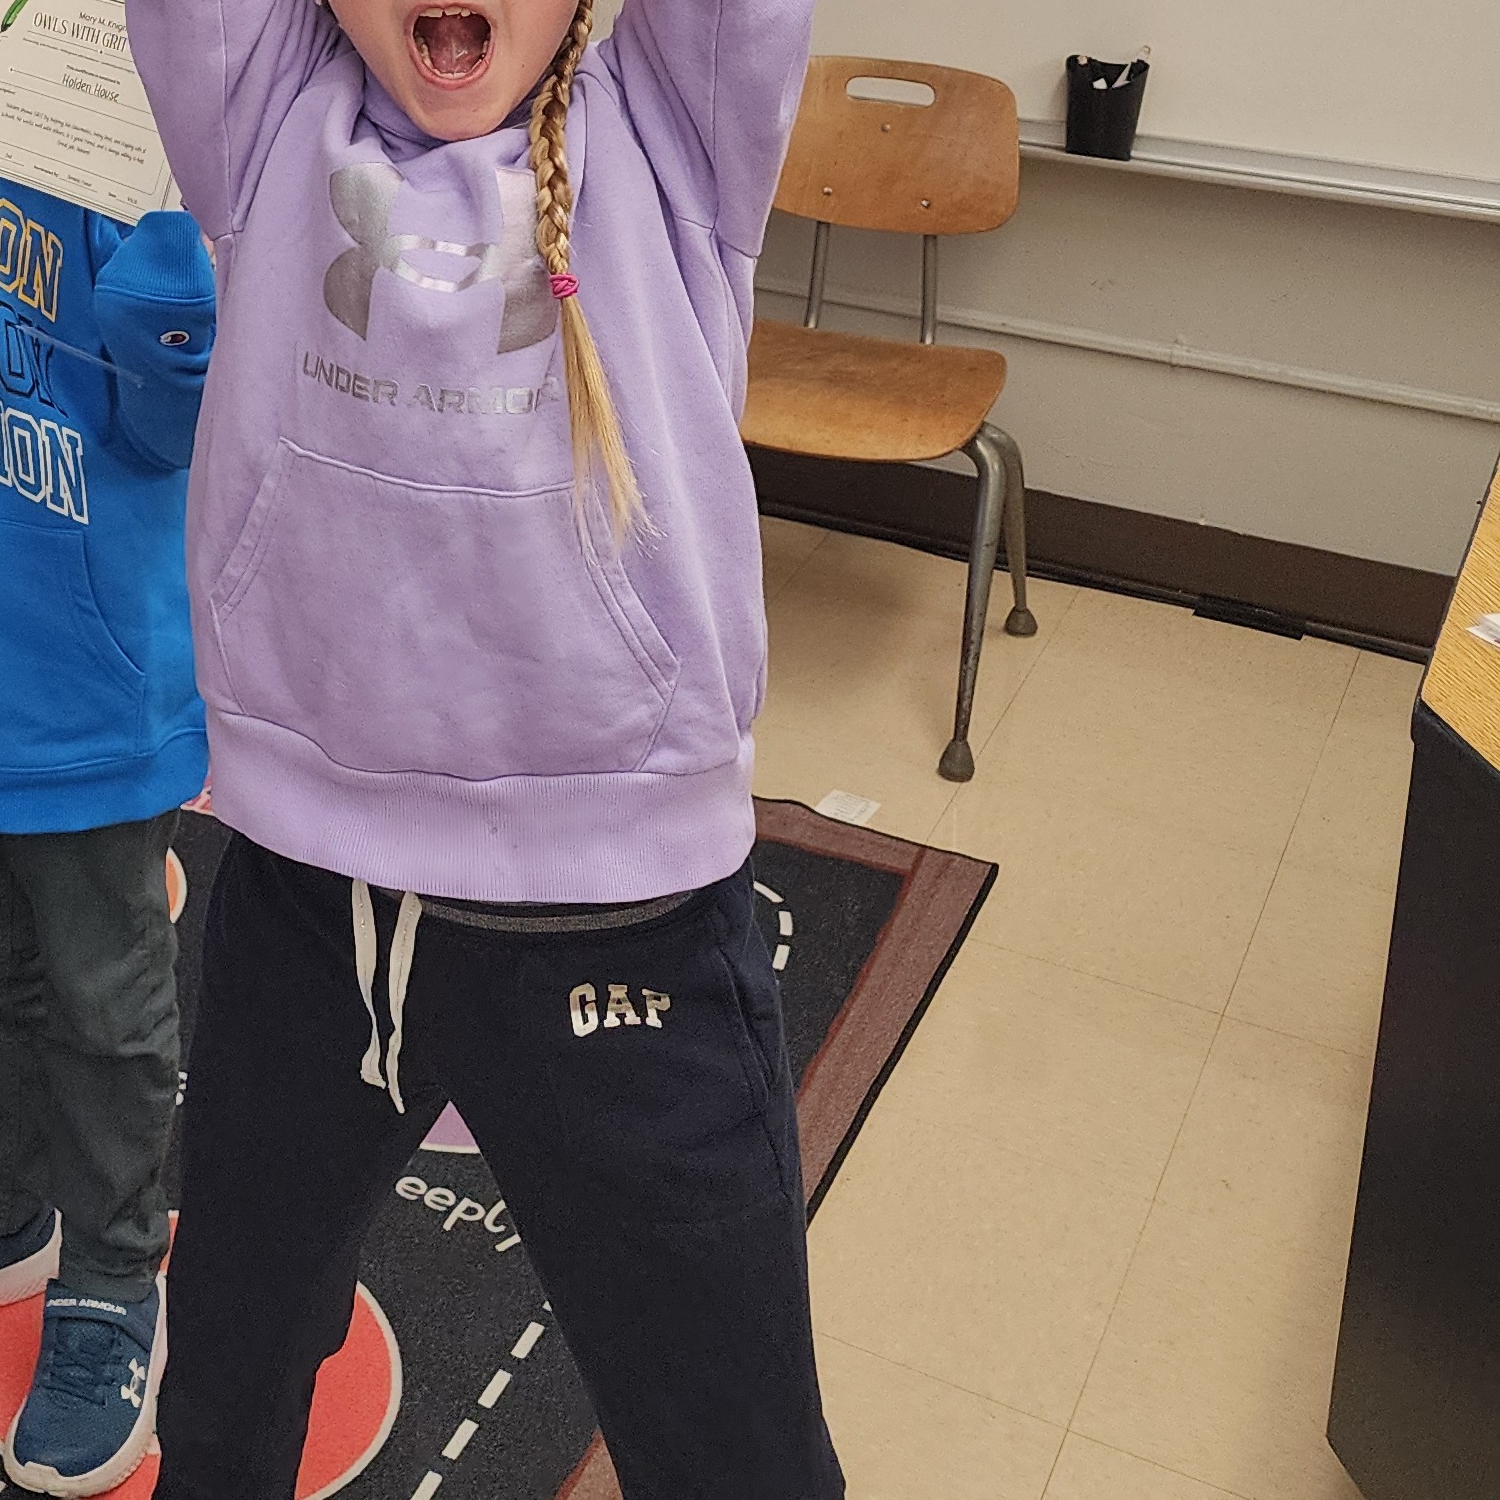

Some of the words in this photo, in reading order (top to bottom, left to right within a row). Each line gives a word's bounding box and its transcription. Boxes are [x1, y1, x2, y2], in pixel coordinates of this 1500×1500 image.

[33, 12, 70, 36] OWLS
[71, 22, 102, 46] WITH
[61, 73, 92, 96] Holden
[94, 84, 121, 103] House
[303, 351, 400, 407] UNDER
[569, 981, 672, 1038] GAP
